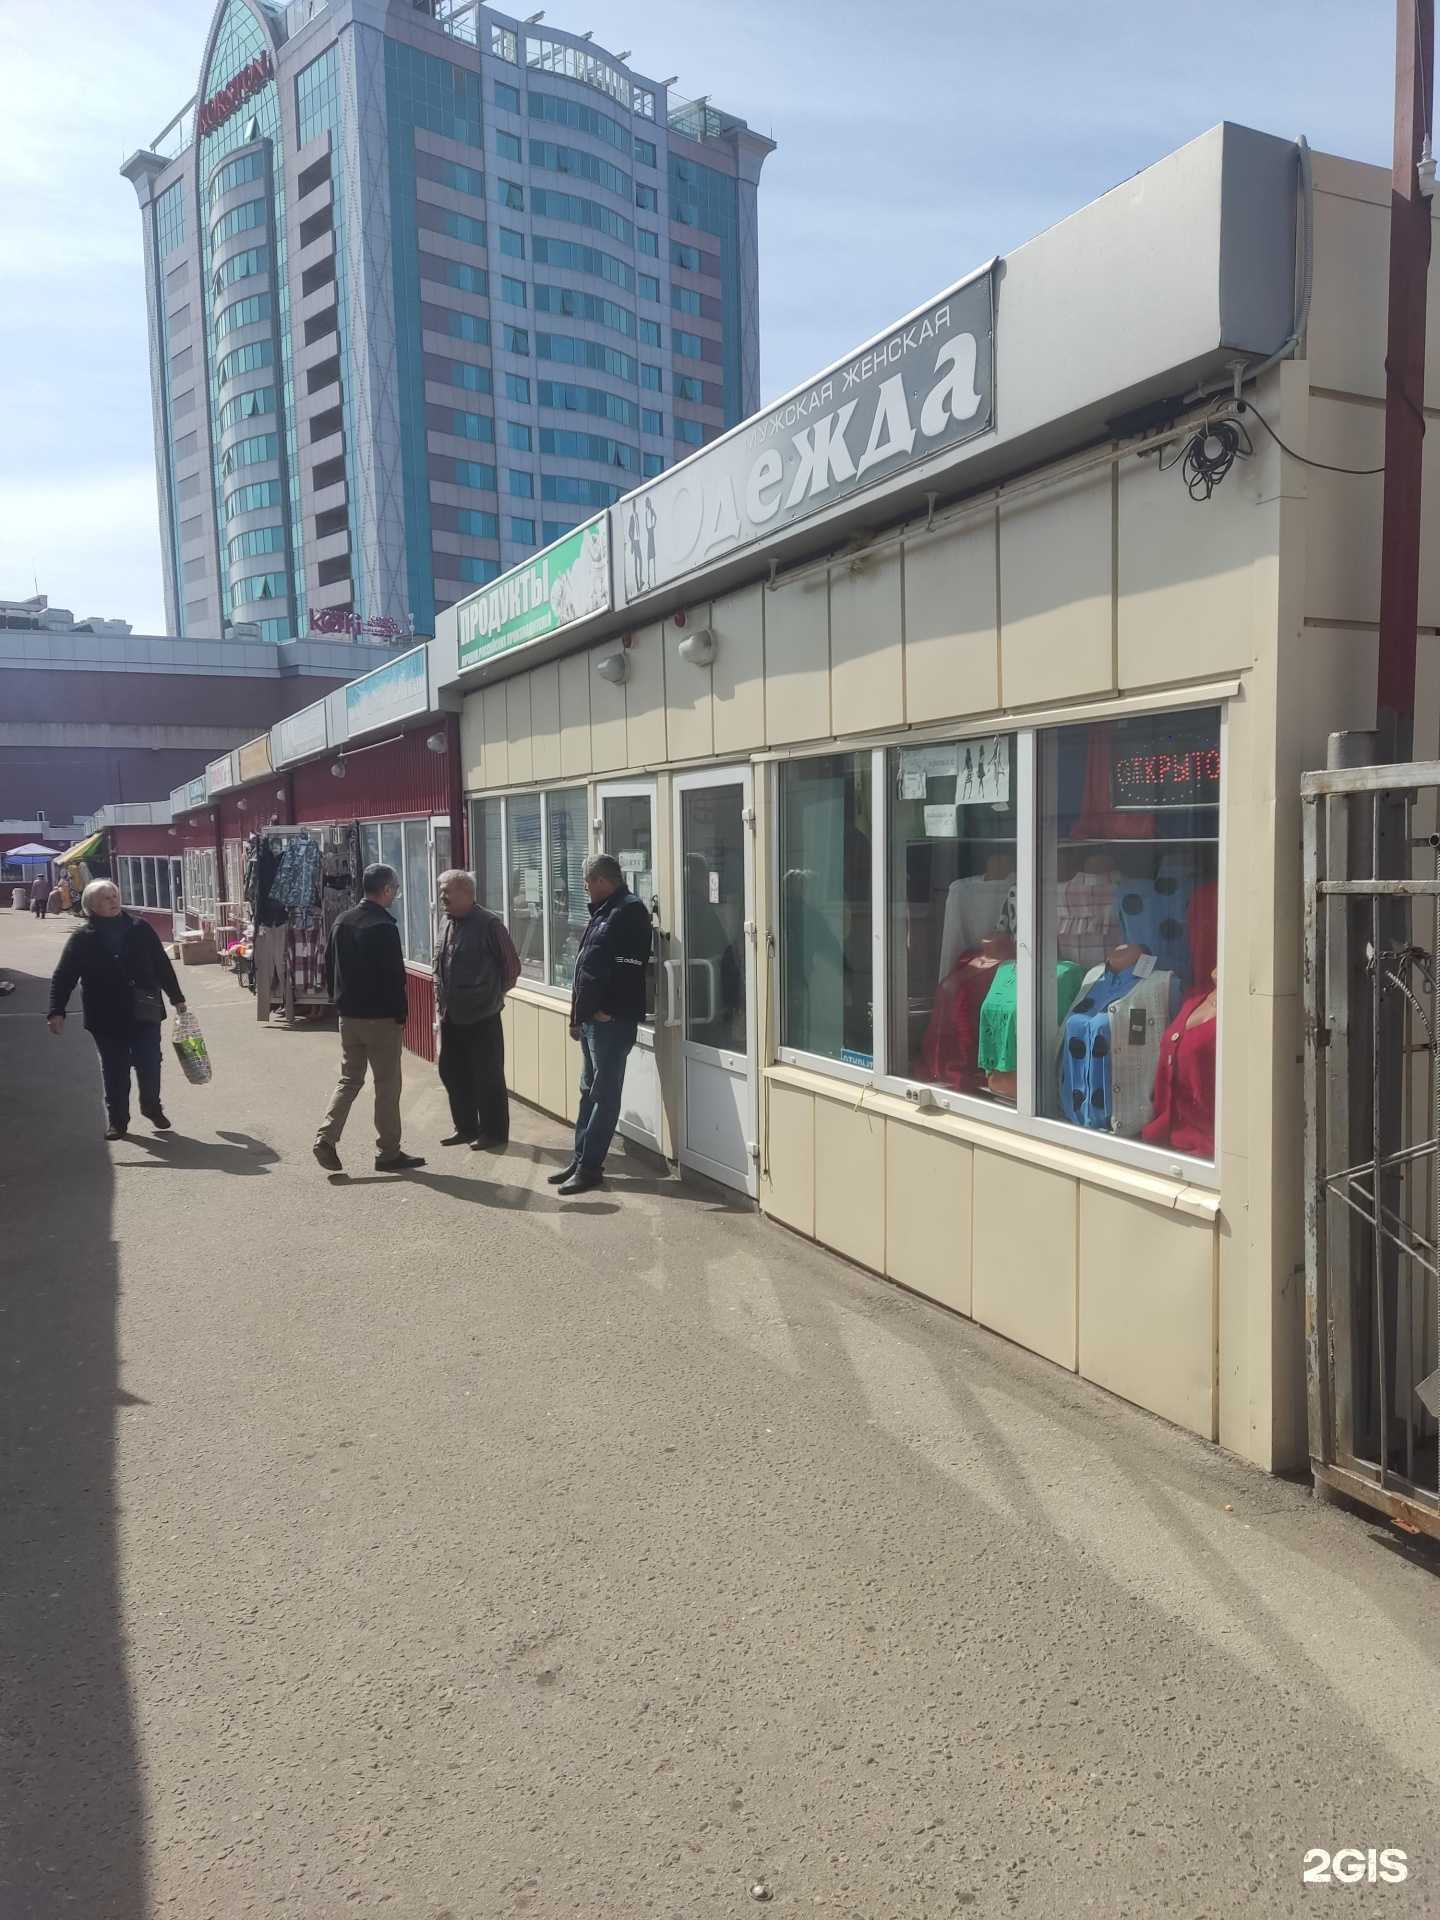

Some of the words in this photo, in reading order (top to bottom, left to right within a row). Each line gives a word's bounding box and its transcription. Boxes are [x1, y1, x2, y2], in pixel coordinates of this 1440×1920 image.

[744, 383, 834, 450] МУЖСКАЯ
[842, 305, 951, 394] ЖЕНСКАЯ
[460, 558, 549, 646] ПРОДУКТЫ
